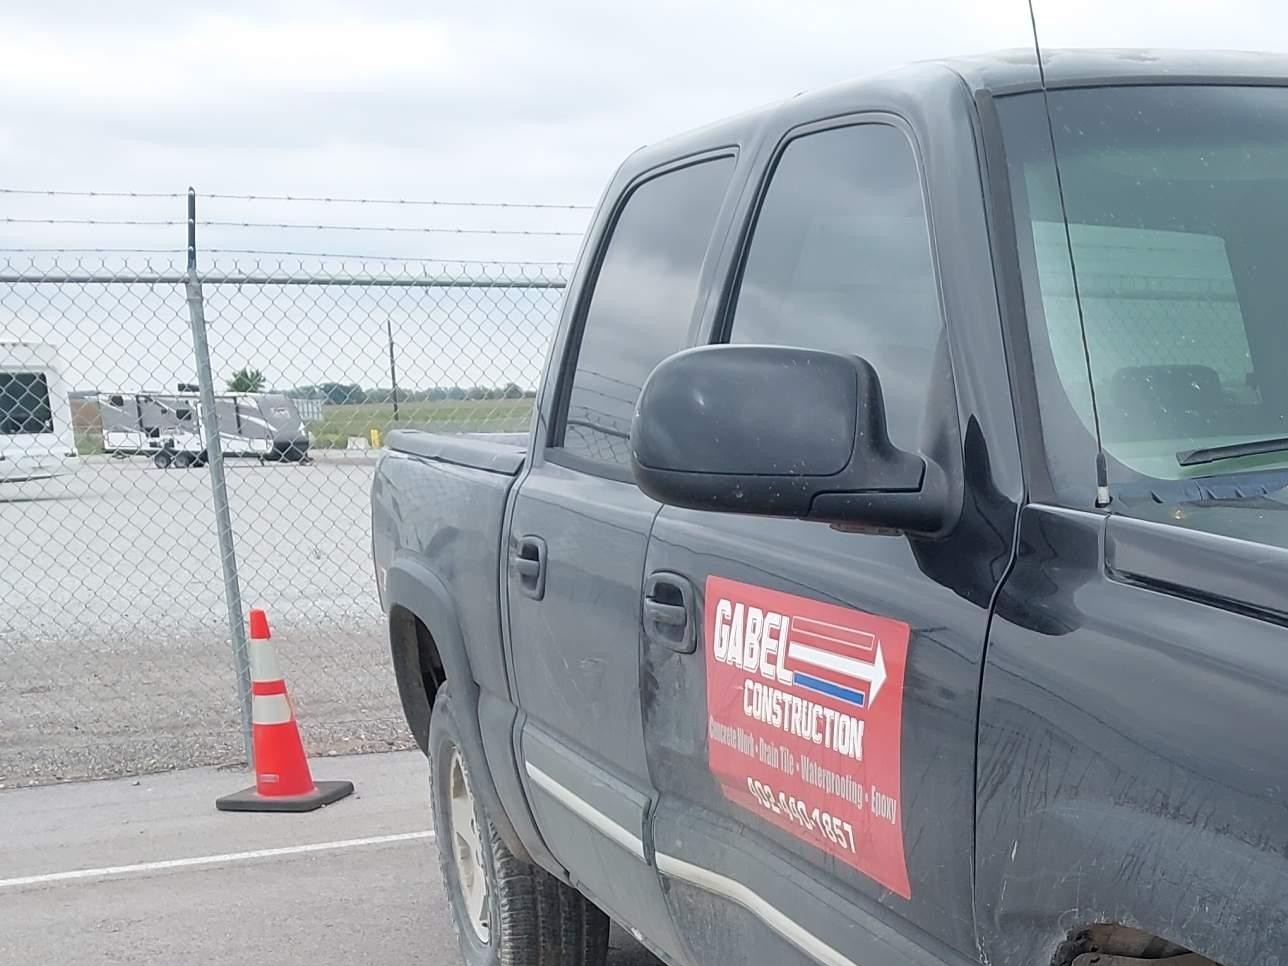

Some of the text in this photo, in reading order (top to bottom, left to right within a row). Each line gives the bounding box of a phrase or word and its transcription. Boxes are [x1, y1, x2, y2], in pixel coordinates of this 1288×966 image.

[713, 598, 795, 686] GABEL
[743, 679, 864, 761] CONSTRUCTION
[736, 727, 755, 758] Work
[759, 737, 779, 769] Drain
[780, 745, 794, 776] Tile
[800, 754, 863, 810] Waterproofing
[871, 785, 897, 825] Epoxy
[747, 777, 856, 853] 402-440-1857
